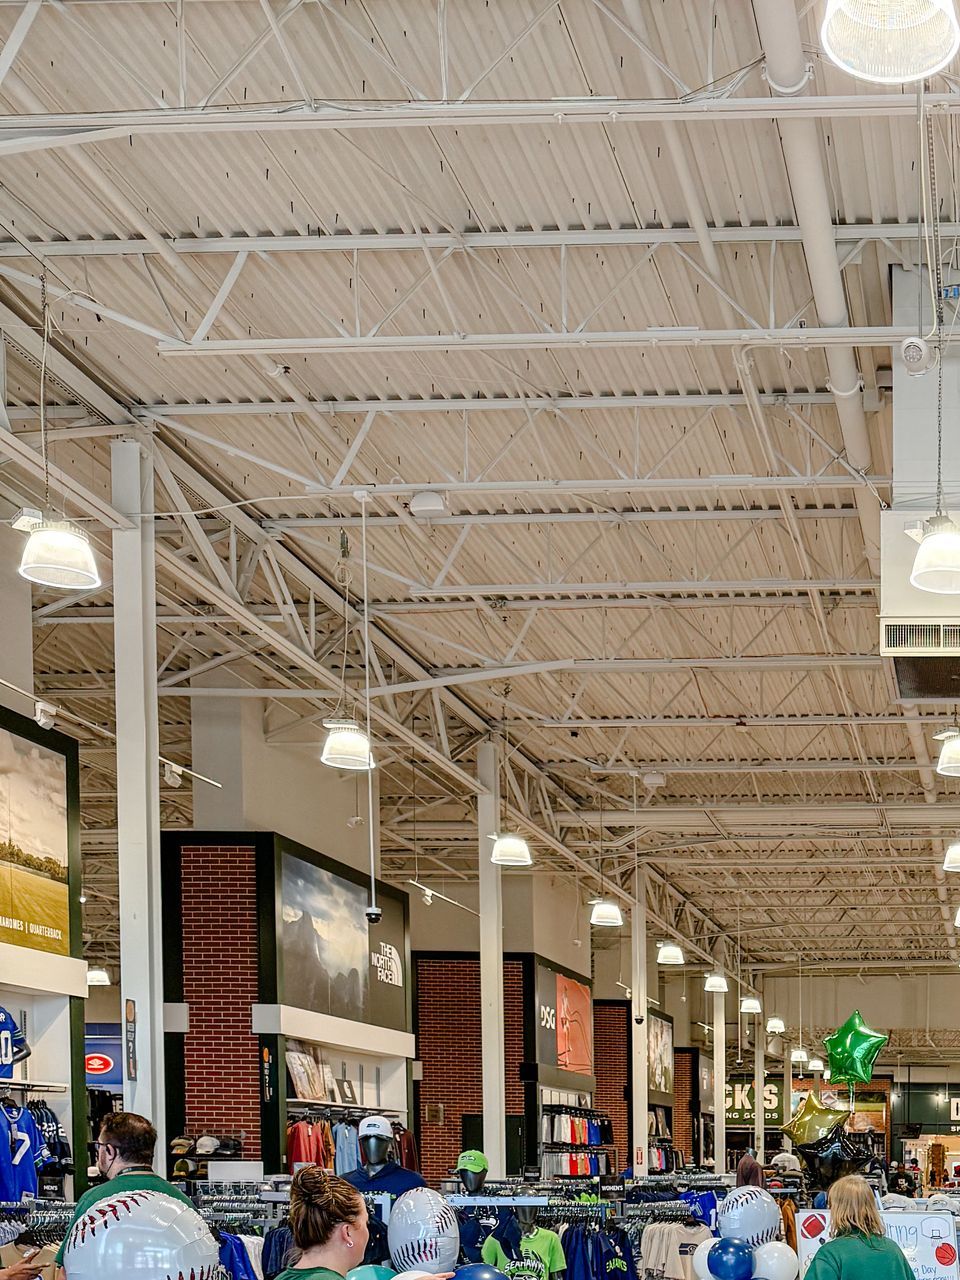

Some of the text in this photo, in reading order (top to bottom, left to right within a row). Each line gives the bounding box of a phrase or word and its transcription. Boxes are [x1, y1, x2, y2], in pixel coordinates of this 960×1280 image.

[380, 941, 392, 958] THE
[371, 951, 392, 971] NORTH
[377, 967, 392, 984] FACE
[540, 1004, 556, 1030] DSG
[921, 1264, 937, 1276] Day
